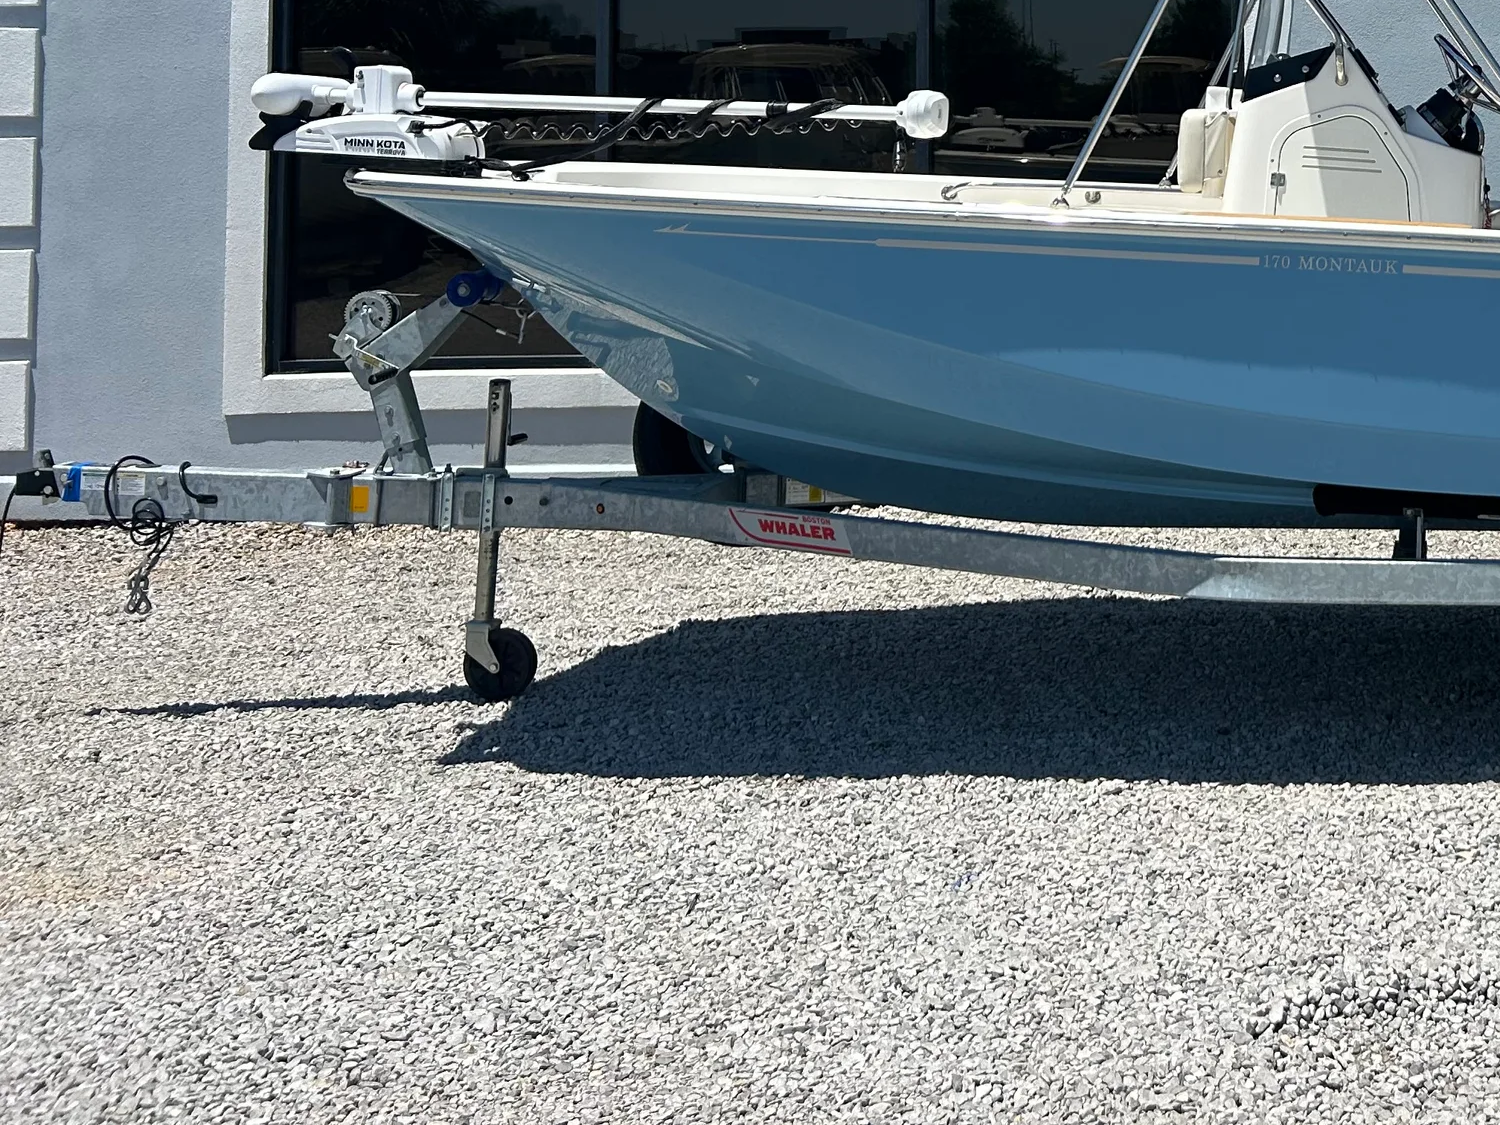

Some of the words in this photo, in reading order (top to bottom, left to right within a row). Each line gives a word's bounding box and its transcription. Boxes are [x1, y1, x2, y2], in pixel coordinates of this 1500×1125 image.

[344, 137, 374, 148] MINN
[376, 139, 406, 150] KOTA
[1263, 254, 1291, 269] 170
[1298, 255, 1398, 275] MONTAUK
[801, 515, 831, 526] BOSTON
[757, 518, 836, 541] WHALER
